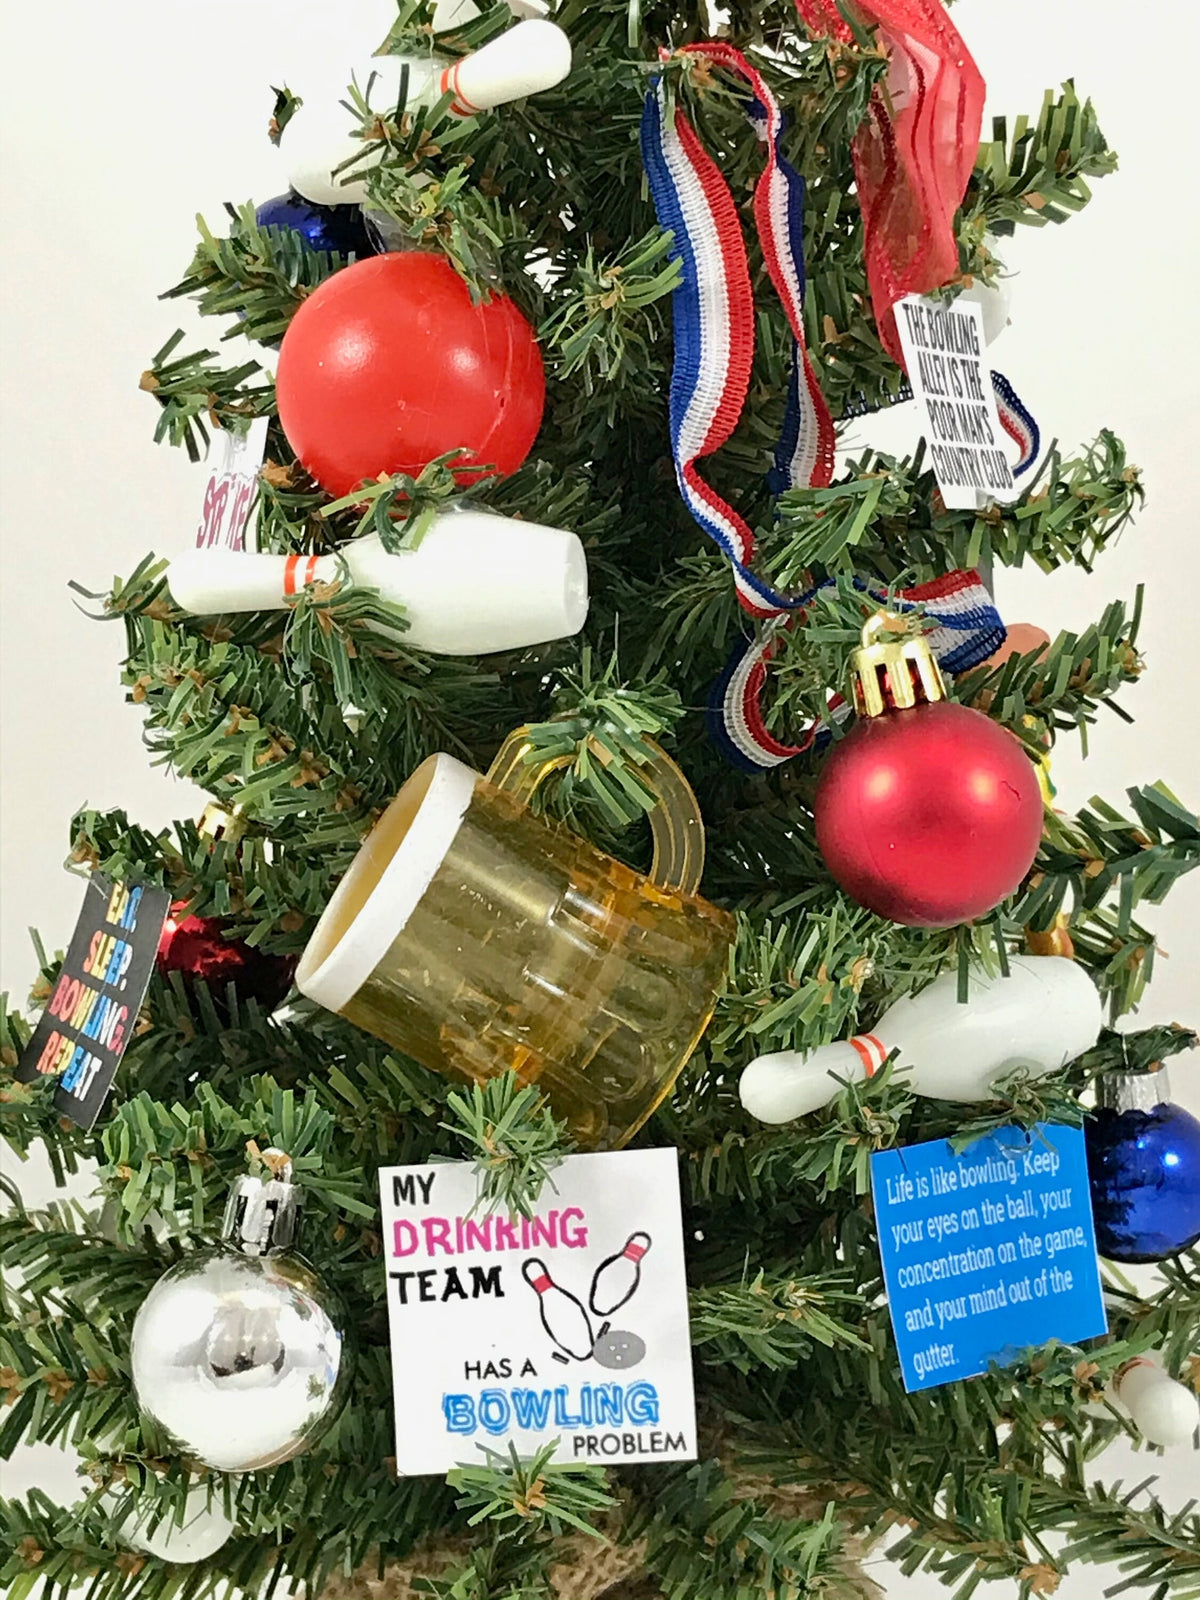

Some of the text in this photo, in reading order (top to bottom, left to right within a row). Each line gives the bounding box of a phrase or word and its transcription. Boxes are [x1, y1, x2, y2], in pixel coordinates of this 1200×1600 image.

[902, 303, 980, 356] THE BOWLING
[917, 351, 985, 401] ALLEY IS THE
[926, 398, 962, 442] POOR
[930, 443, 1013, 489] COUNTRY CLUB
[82, 930, 133, 992] SLEEP.
[36, 1030, 102, 1102] REPEAT
[392, 1172, 436, 1206] MY
[886, 1150, 1060, 1205] Life is like bowling. Keep
[392, 1207, 588, 1257] DRINKING
[891, 1187, 1072, 1252] your eyes on the ball, your
[897, 1225, 1087, 1289] concentration on the game,
[390, 1265, 505, 1304] TEAM
[905, 1266, 1074, 1332] and your mind out of the
[464, 1358, 538, 1380] HAS A
[913, 1342, 960, 1381] gutter.
[441, 1380, 659, 1436] BOWLING
[573, 1431, 687, 1457] PROBLEM
